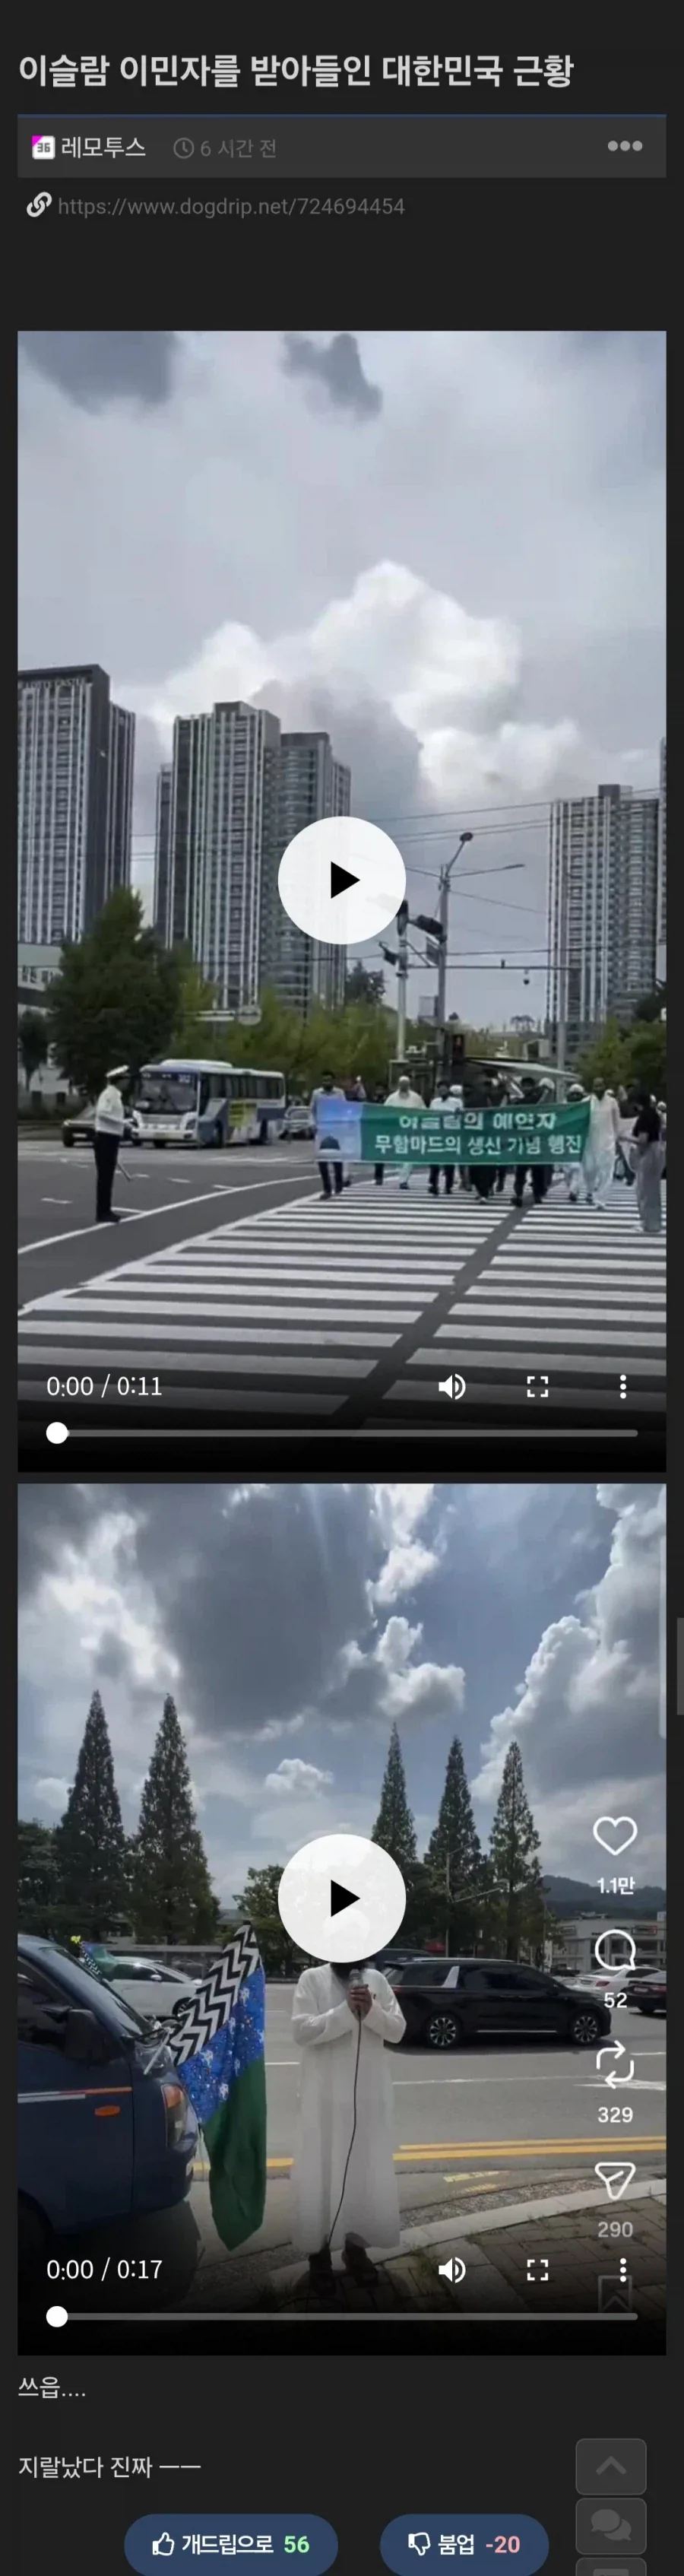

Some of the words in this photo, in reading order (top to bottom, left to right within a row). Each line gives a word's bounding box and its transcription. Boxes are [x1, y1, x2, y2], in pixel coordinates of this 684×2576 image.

[20, 55, 109, 87] 이슬람
[121, 55, 240, 87] 이민자를
[252, 55, 370, 87] 받아들인
[383, 55, 503, 87] 대한민국
[514, 55, 574, 87] 근황
[62, 136, 146, 159] 레모투스
[201, 141, 211, 157] 6
[218, 139, 254, 158] 시간
[260, 139, 277, 158] 전
[58, 197, 406, 219] https://www.dogdrip.net/724694454
[375, 1134, 461, 1155] 무함마드의
[467, 1136, 501, 1156] 생신
[508, 1136, 541, 1155] 기념
[548, 1134, 581, 1155] 행진
[18, 2456, 104, 2479] 지랄났다
[110, 2456, 154, 2479] 진짜
[182, 2533, 274, 2555] 개드립으로
[283, 2535, 310, 2553] 56
[438, 2533, 474, 2555] 붐업
[486, 2536, 521, 2553] -20
